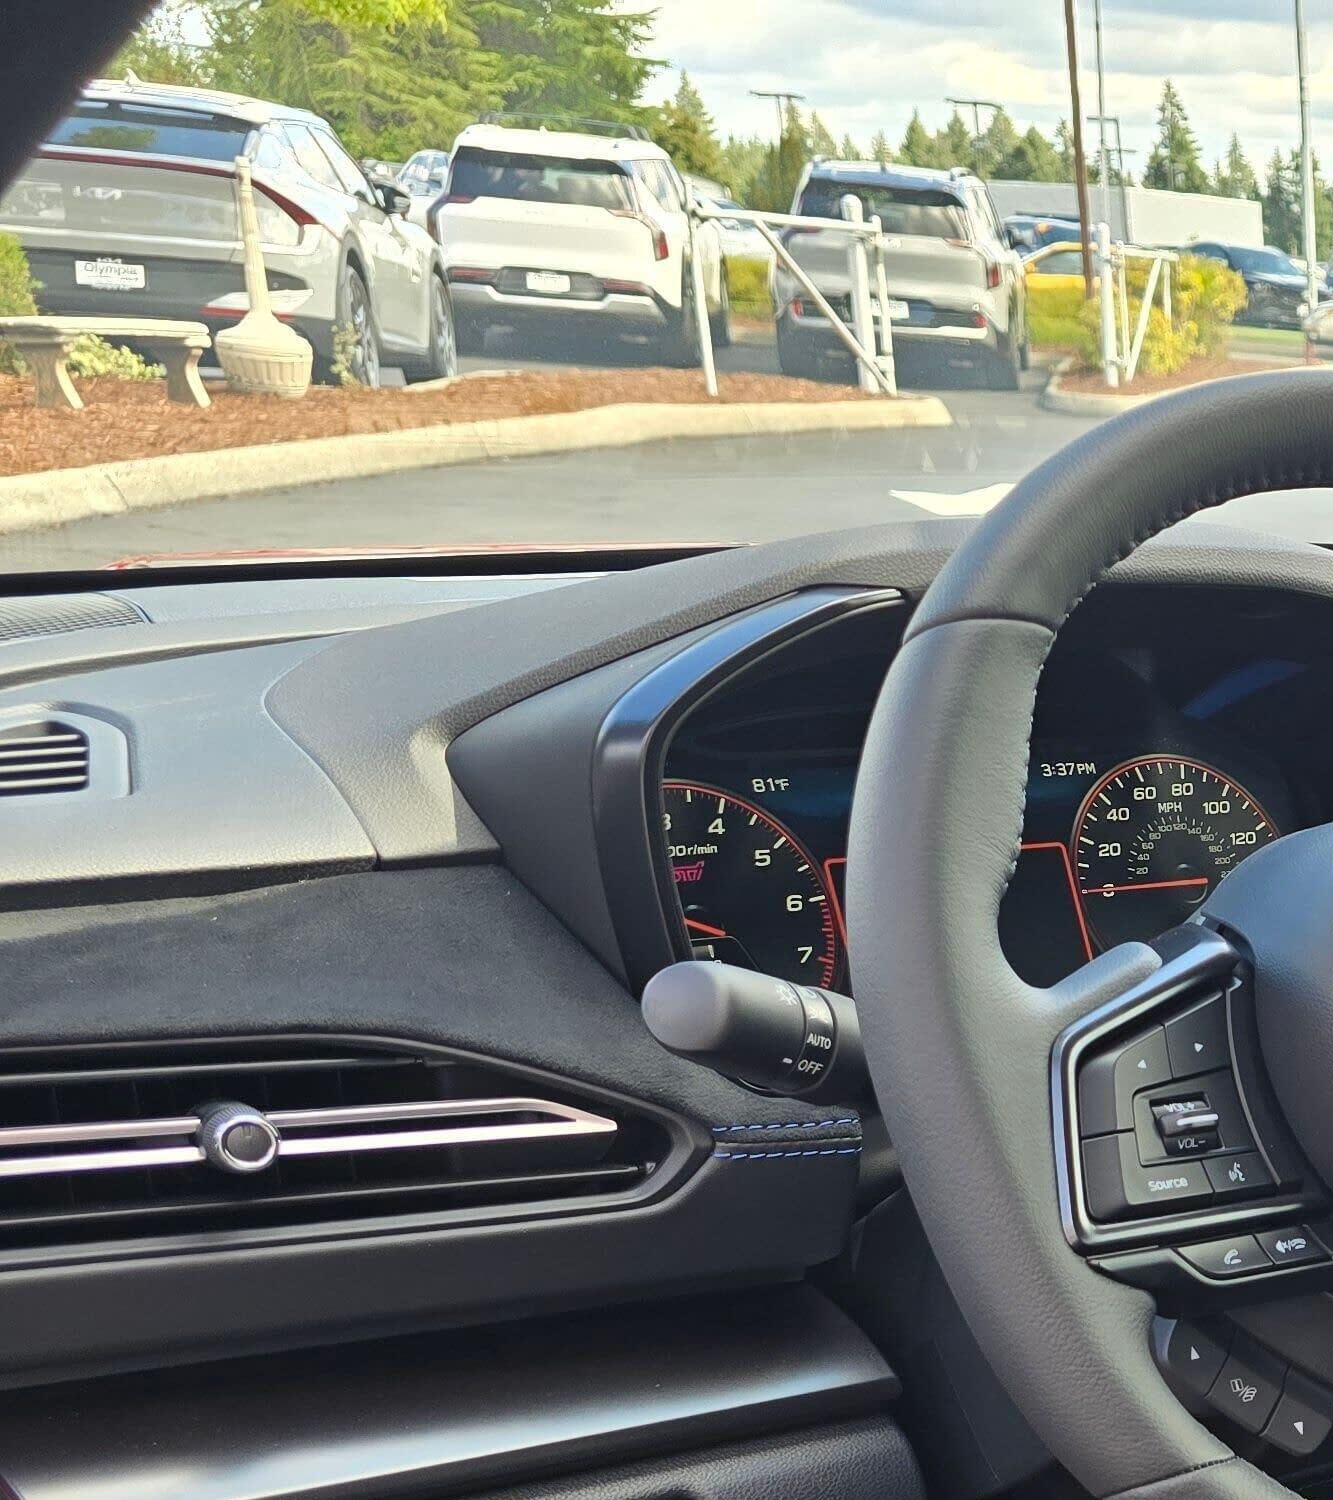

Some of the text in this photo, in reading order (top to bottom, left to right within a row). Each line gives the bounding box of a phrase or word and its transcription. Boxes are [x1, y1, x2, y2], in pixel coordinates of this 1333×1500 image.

[1133, 786, 1157, 800] 60
[1171, 782, 1194, 796] 80
[1106, 807, 1130, 822] 40
[1158, 801, 1183, 814] MPH
[1202, 800, 1231, 815] 100
[707, 818, 726, 835] 4
[1157, 824, 1173, 832] 100
[1173, 822, 1188, 831] 120
[1187, 827, 1202, 835] 140
[1200, 833, 1215, 842] 160
[1230, 831, 1257, 846] 120
[1098, 842, 1121, 857] 20
[1142, 842, 1154, 850] 60
[1208, 845, 1223, 853] 180
[754, 849, 771, 867] 5
[1137, 853, 1150, 861] 40
[1214, 857, 1231, 865] 200
[1136, 867, 1149, 875] 20
[786, 894, 803, 912] 6
[797, 946, 813, 964] 7
[806, 1033, 832, 1050] AUTO
[797, 1059, 824, 1075] OFF
[1147, 1177, 1189, 1192] Source
